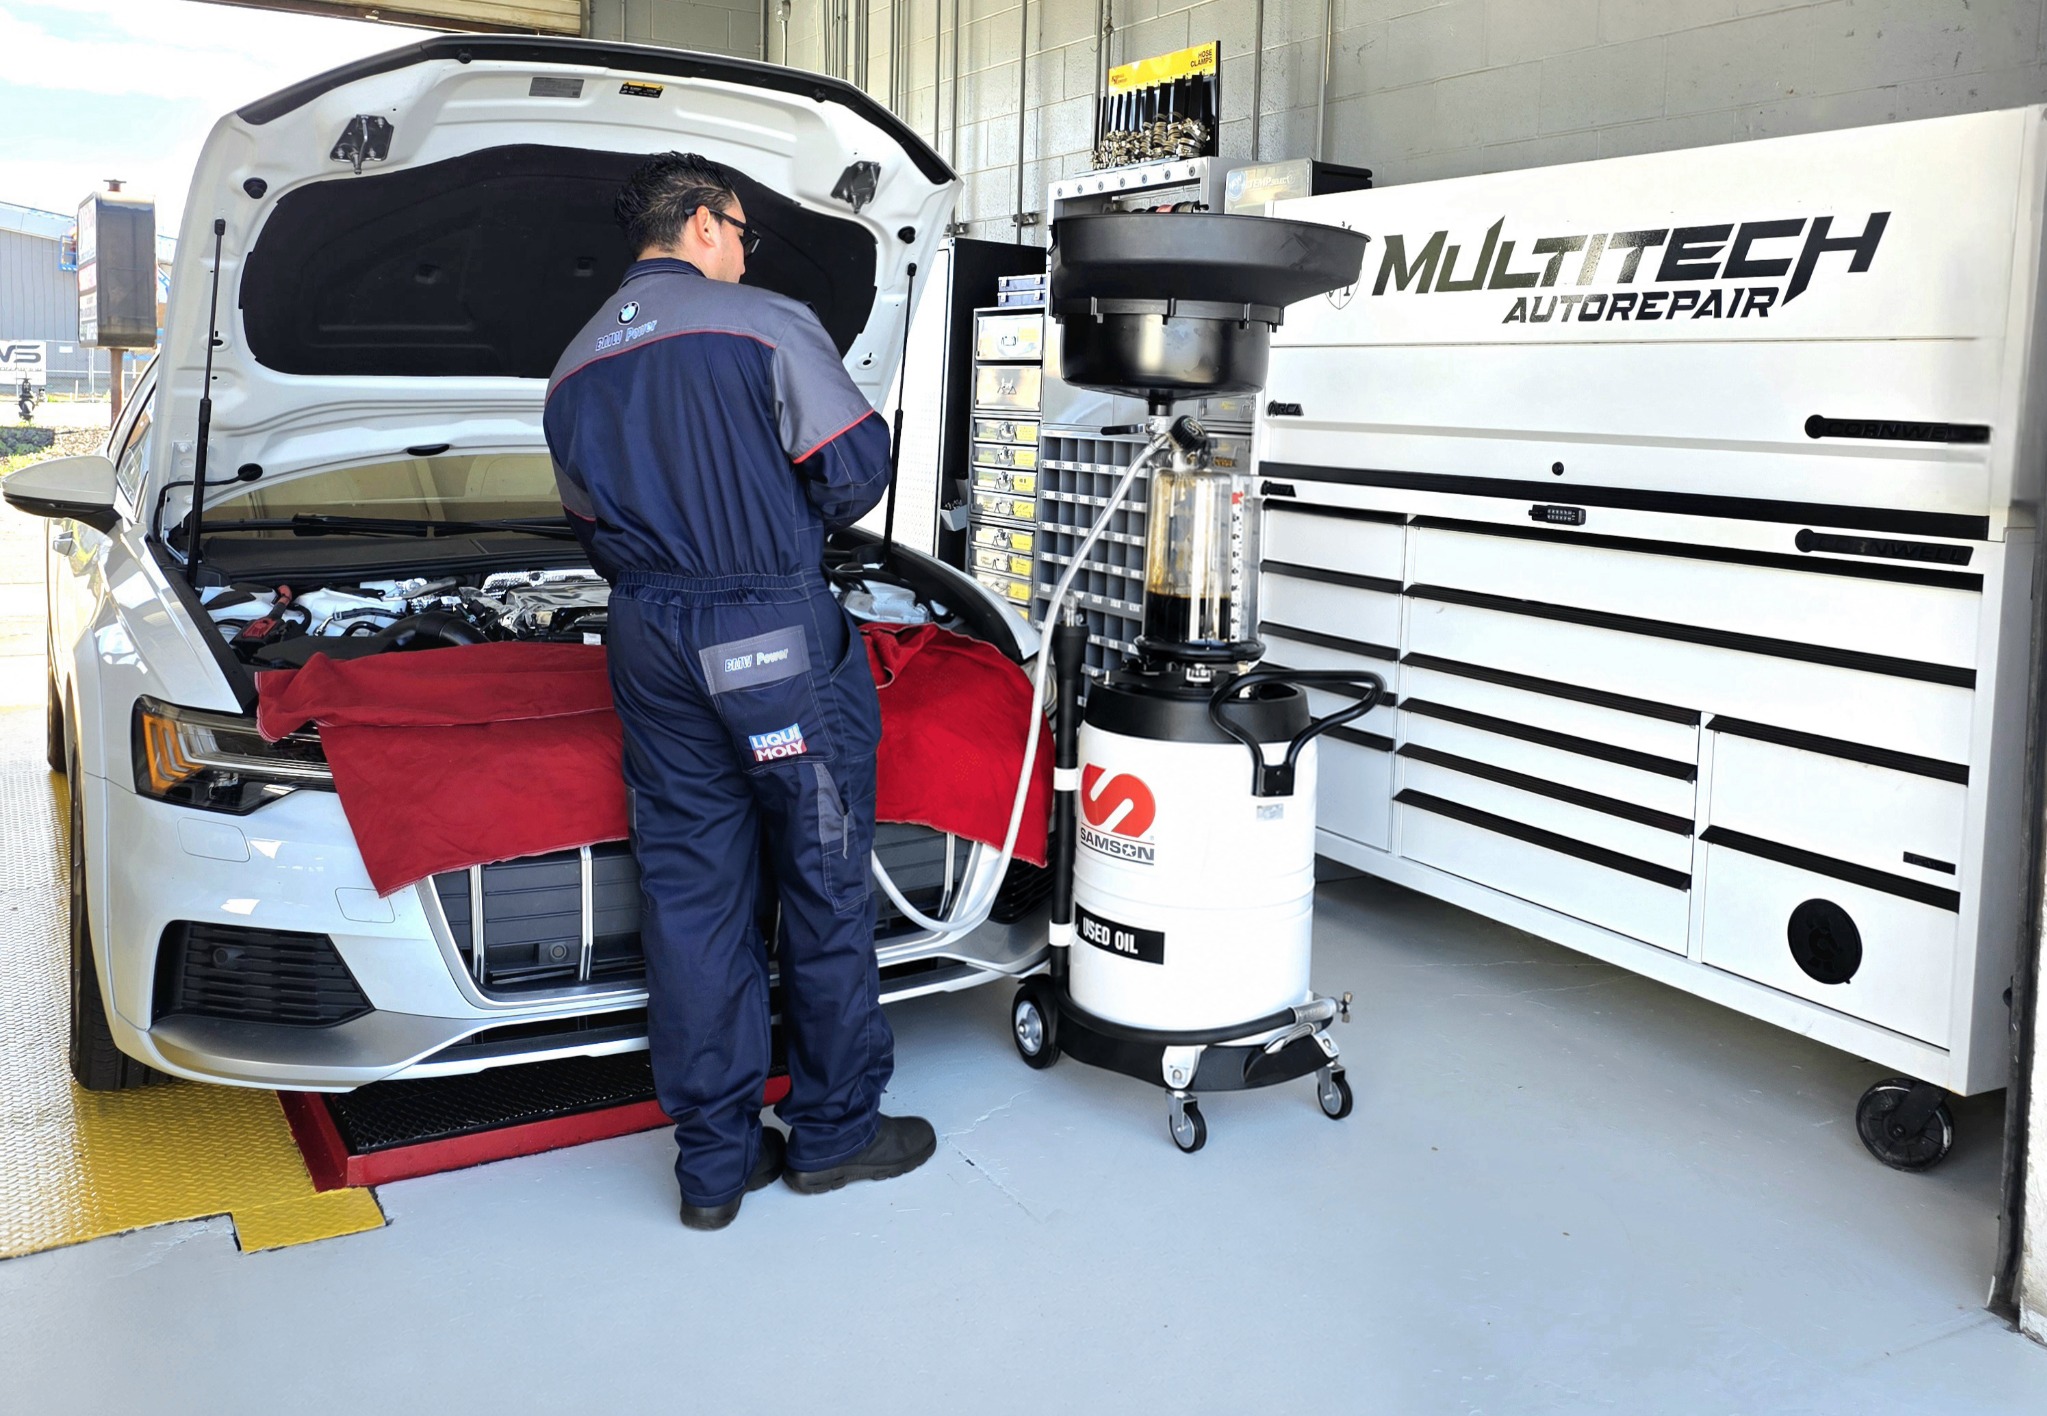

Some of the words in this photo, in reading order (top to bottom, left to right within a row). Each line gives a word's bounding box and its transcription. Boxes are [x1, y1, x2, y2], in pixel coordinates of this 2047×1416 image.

[1190, 57, 1213, 68] CLAMPS
[1198, 49, 1212, 58] HOSE
[1372, 211, 1891, 307] MULTITECH
[1502, 287, 1779, 324] AUTOREPAIR
[595, 329, 623, 351] BMW
[625, 320, 658, 342] Power
[724, 654, 752, 672] BMW
[756, 648, 788, 665] Power
[752, 726, 800, 749] LIQUI
[756, 739, 803, 762] MOLY
[1080, 827, 1154, 861] SAMSON
[1082, 916, 1110, 946] USED
[1115, 930, 1138, 954] OIL
